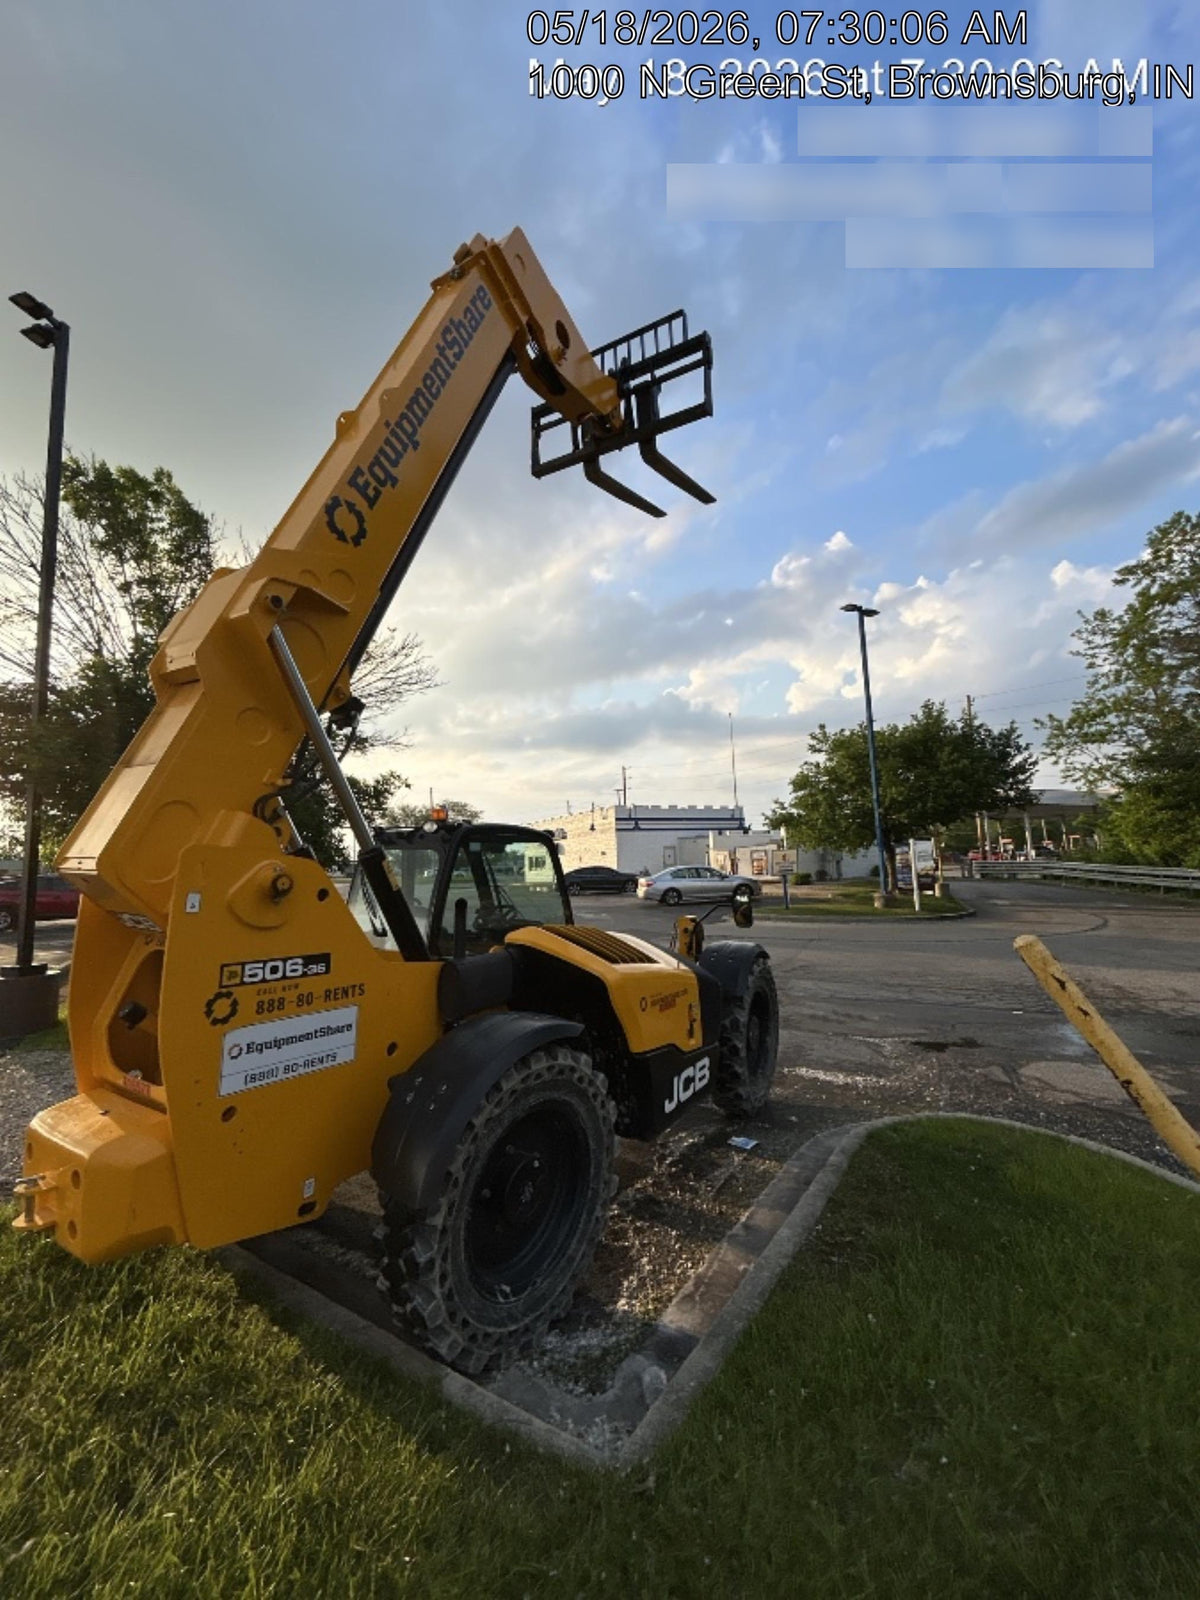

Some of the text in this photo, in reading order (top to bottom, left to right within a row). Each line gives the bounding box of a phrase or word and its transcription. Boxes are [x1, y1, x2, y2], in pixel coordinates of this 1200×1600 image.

[347, 284, 494, 511] EquipmentShare
[244, 1023, 354, 1055] EquipmentShare
[664, 1056, 711, 1114] JCB
